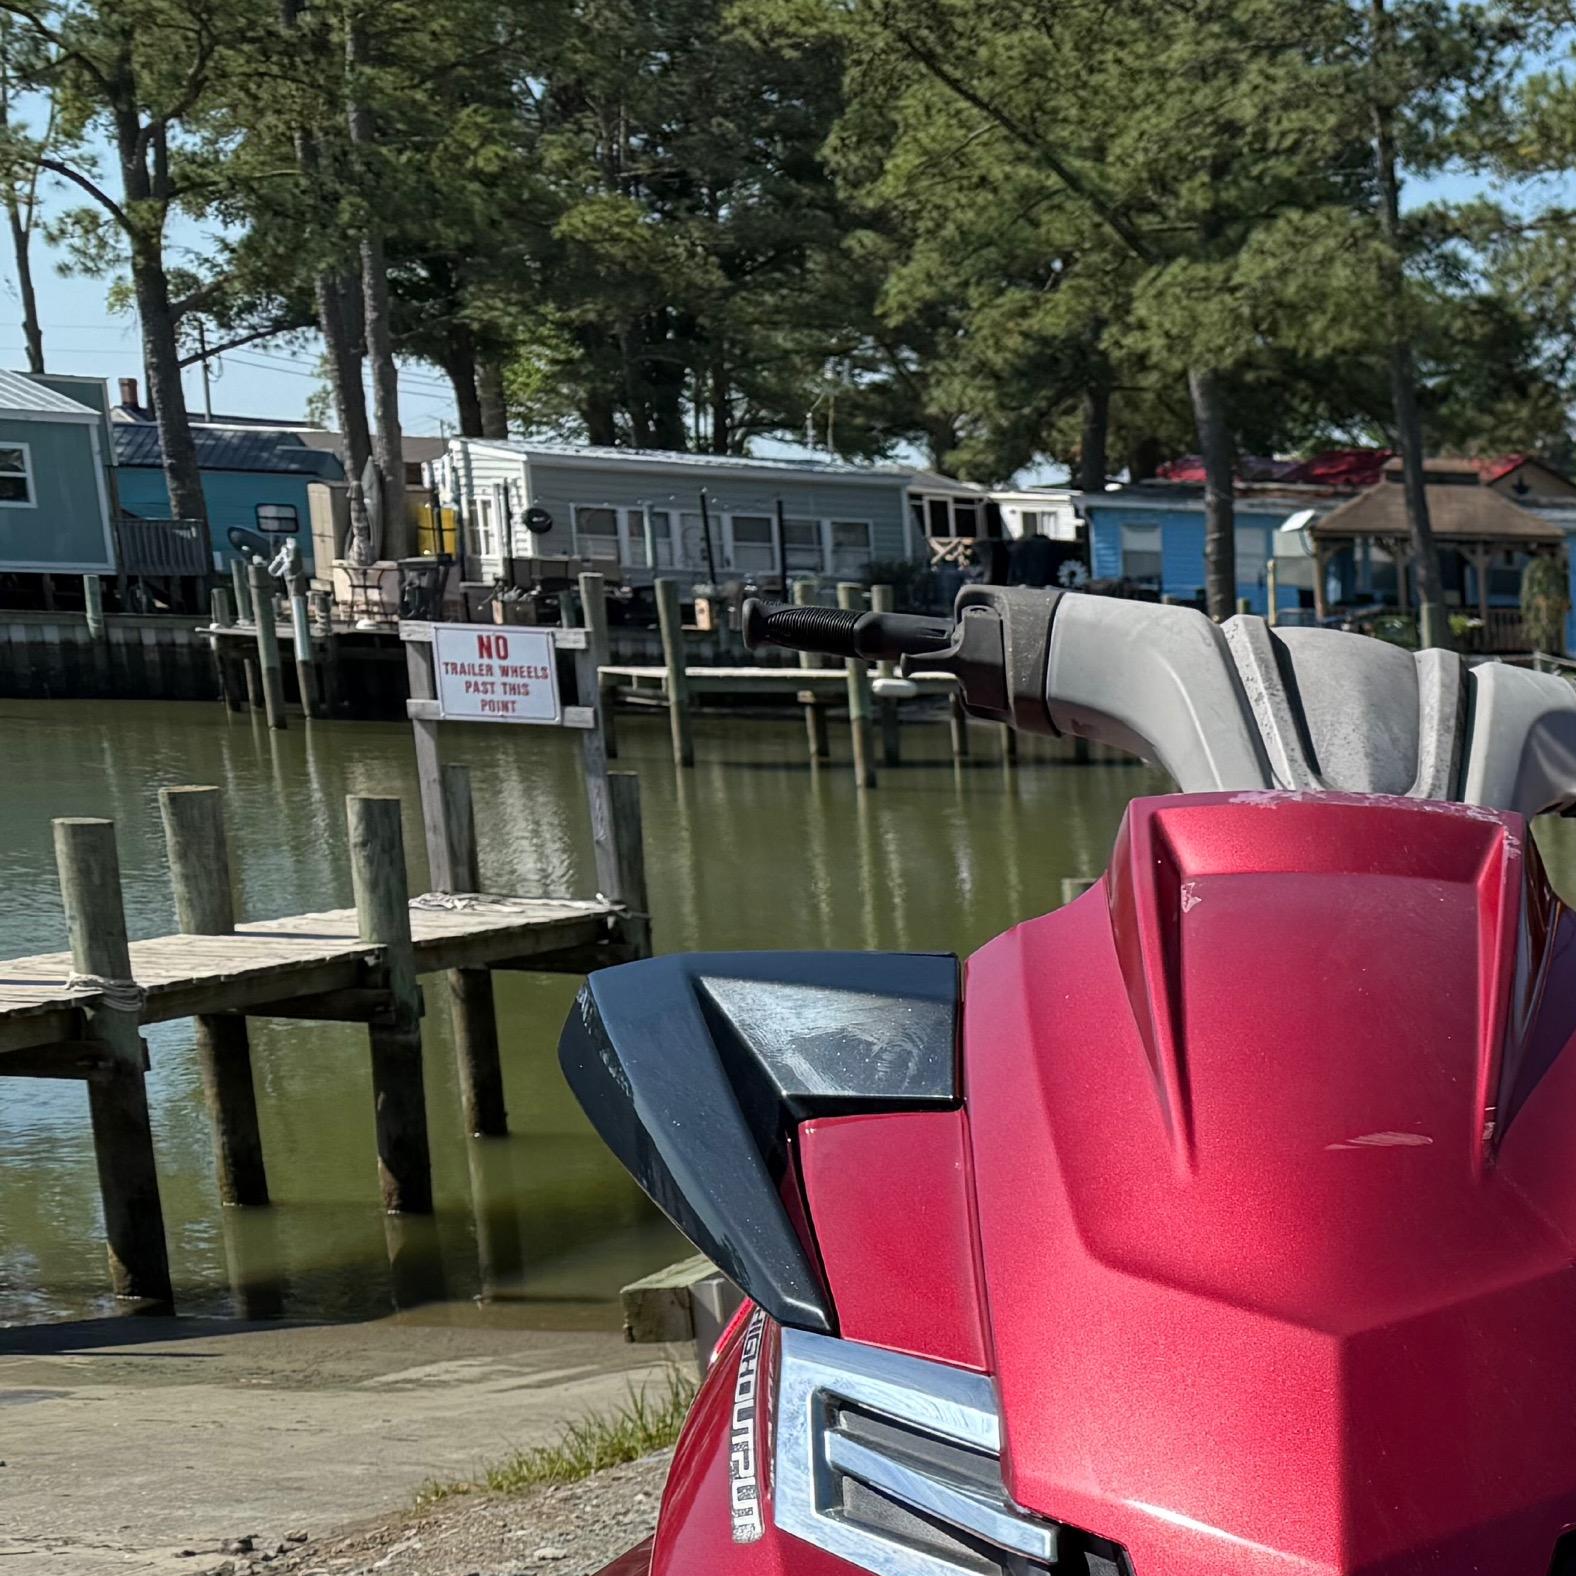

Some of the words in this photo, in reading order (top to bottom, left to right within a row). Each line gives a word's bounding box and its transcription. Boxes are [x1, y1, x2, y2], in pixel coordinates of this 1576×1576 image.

[477, 634, 509, 661] NO
[443, 661, 494, 677] TRAILER
[498, 664, 549, 680] WHEELS
[464, 680, 495, 695] PAST
[500, 682, 530, 696] THIS
[480, 699, 516, 713] POINT
